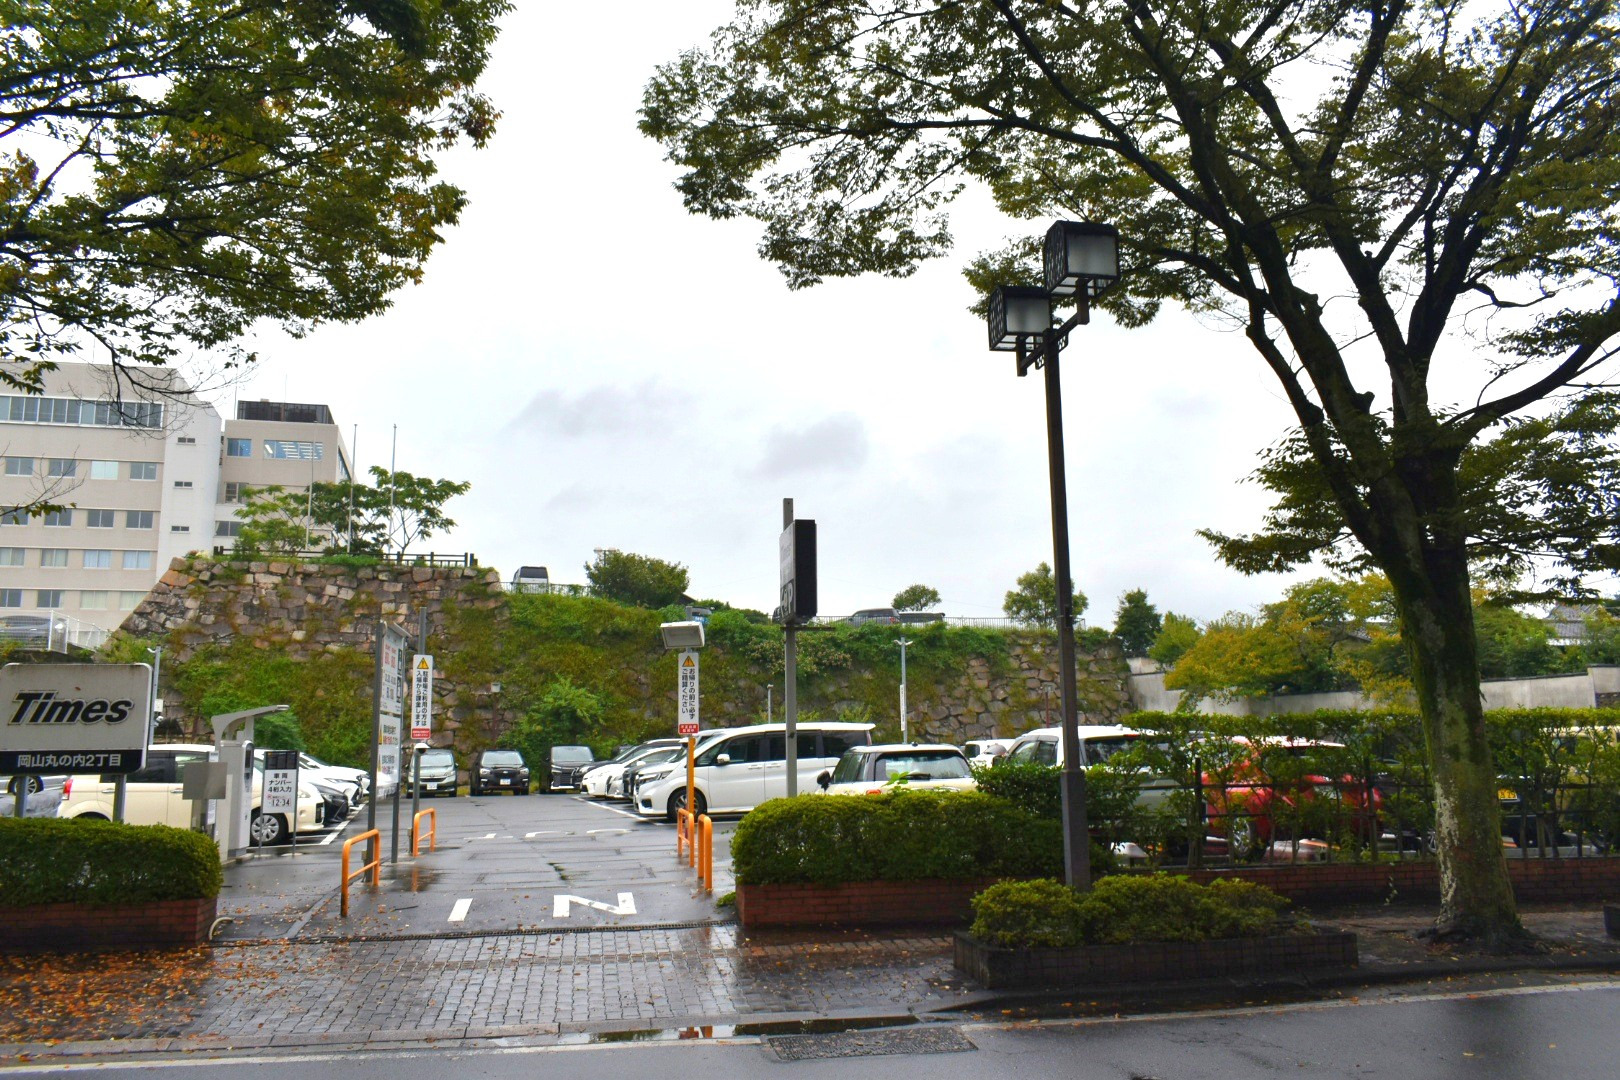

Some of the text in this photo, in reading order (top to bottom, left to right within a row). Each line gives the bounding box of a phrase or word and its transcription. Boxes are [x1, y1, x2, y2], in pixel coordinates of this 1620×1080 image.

[9, 691, 133, 724] Times
[17, 753, 121, 768] 岡山丸の内2丁目
